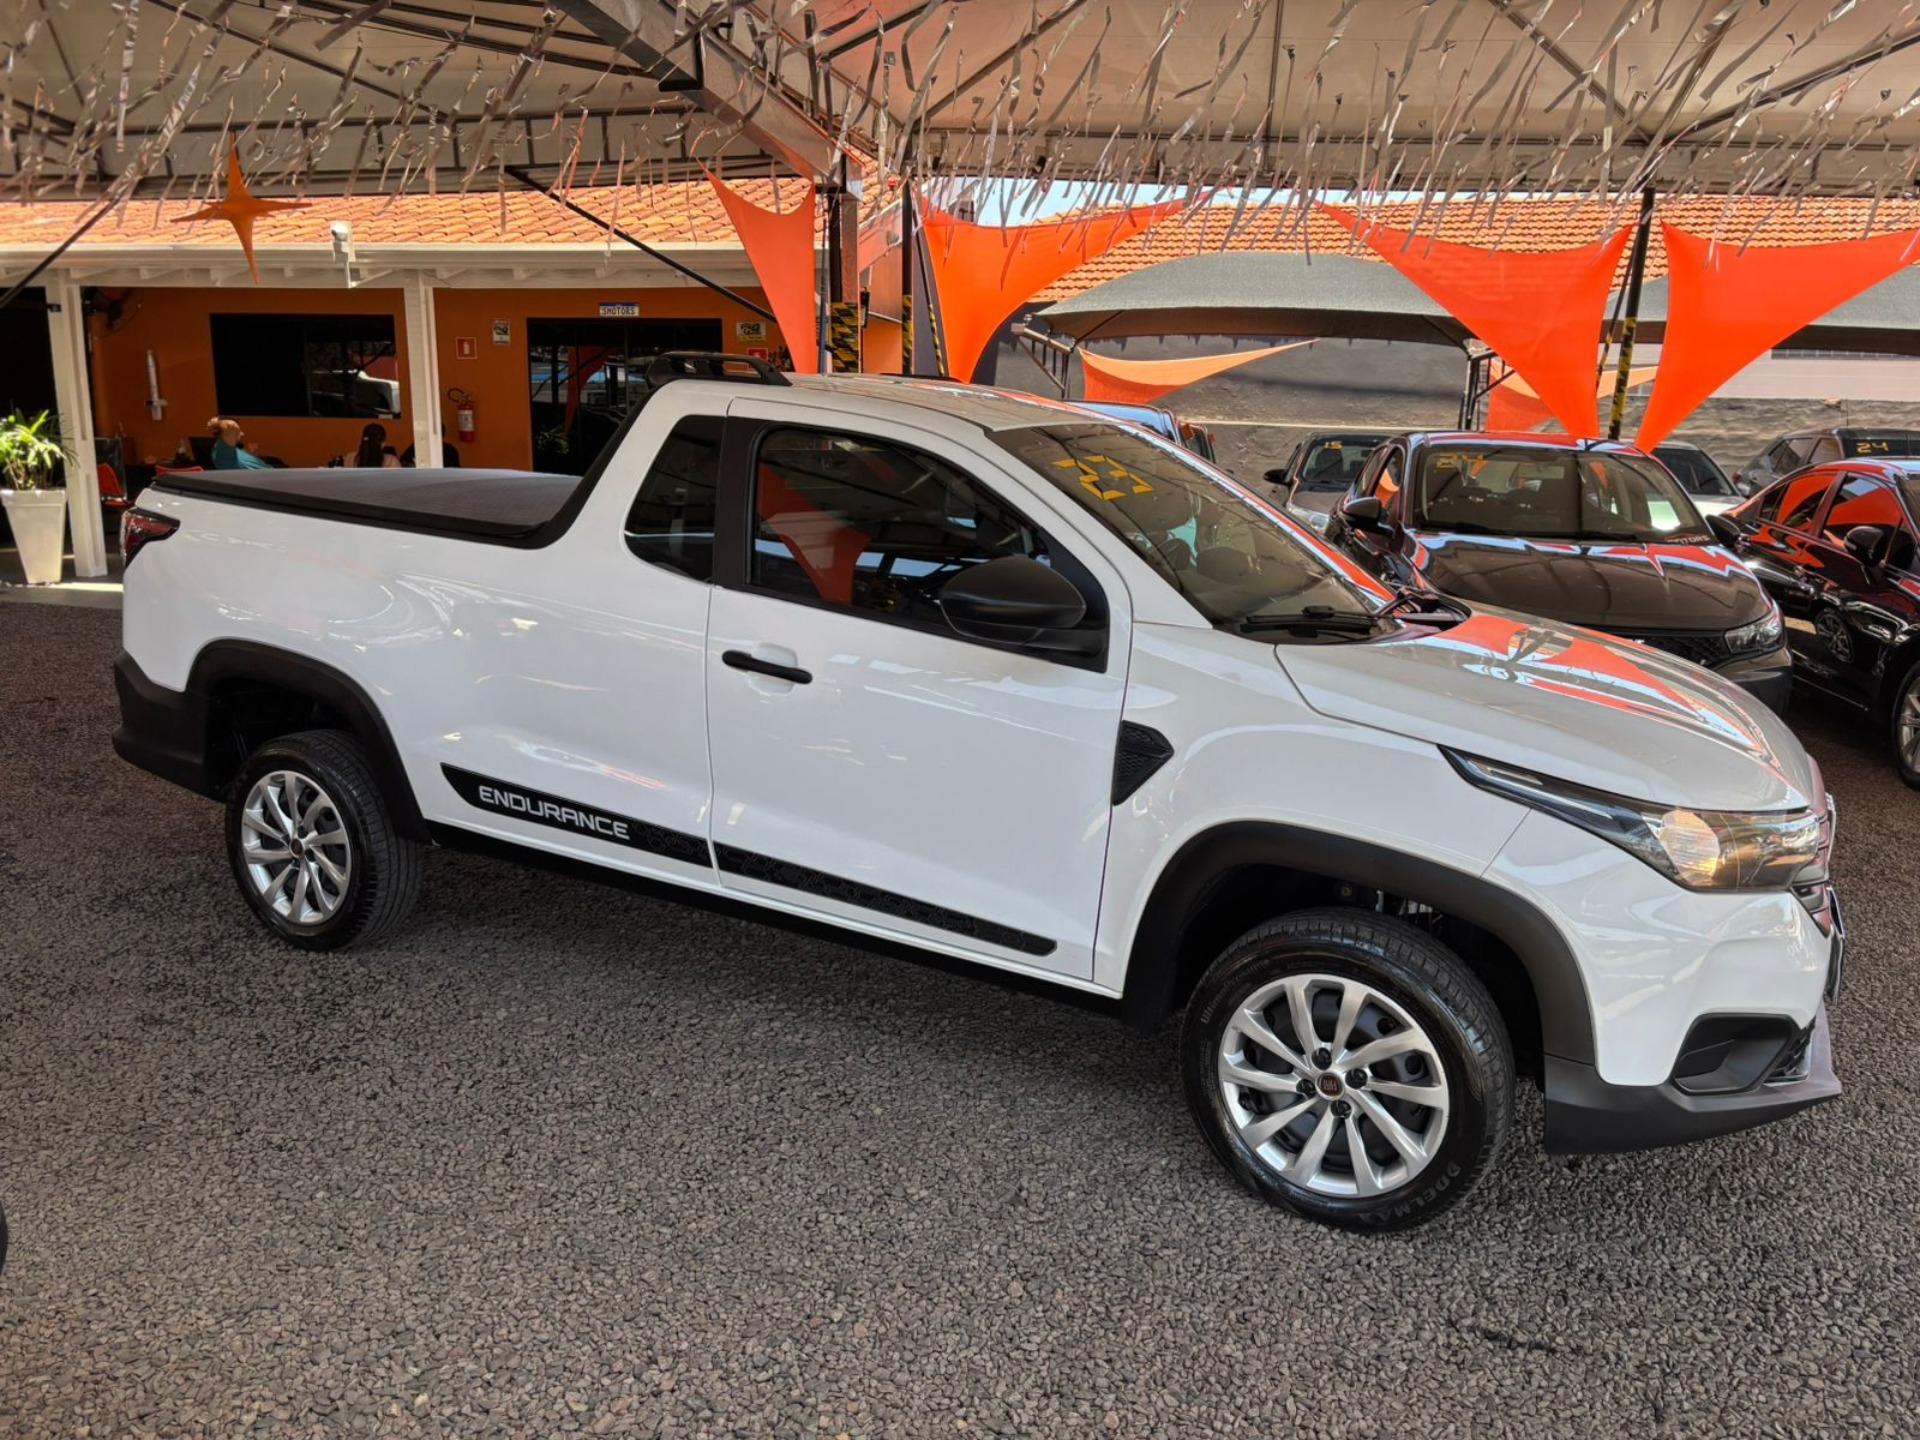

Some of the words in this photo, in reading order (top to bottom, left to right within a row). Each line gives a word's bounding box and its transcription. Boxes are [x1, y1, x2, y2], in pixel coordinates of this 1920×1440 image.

[1856, 442, 1888, 453] 24
[1050, 455, 1153, 500] 23
[478, 784, 630, 840] ENDURANCE
